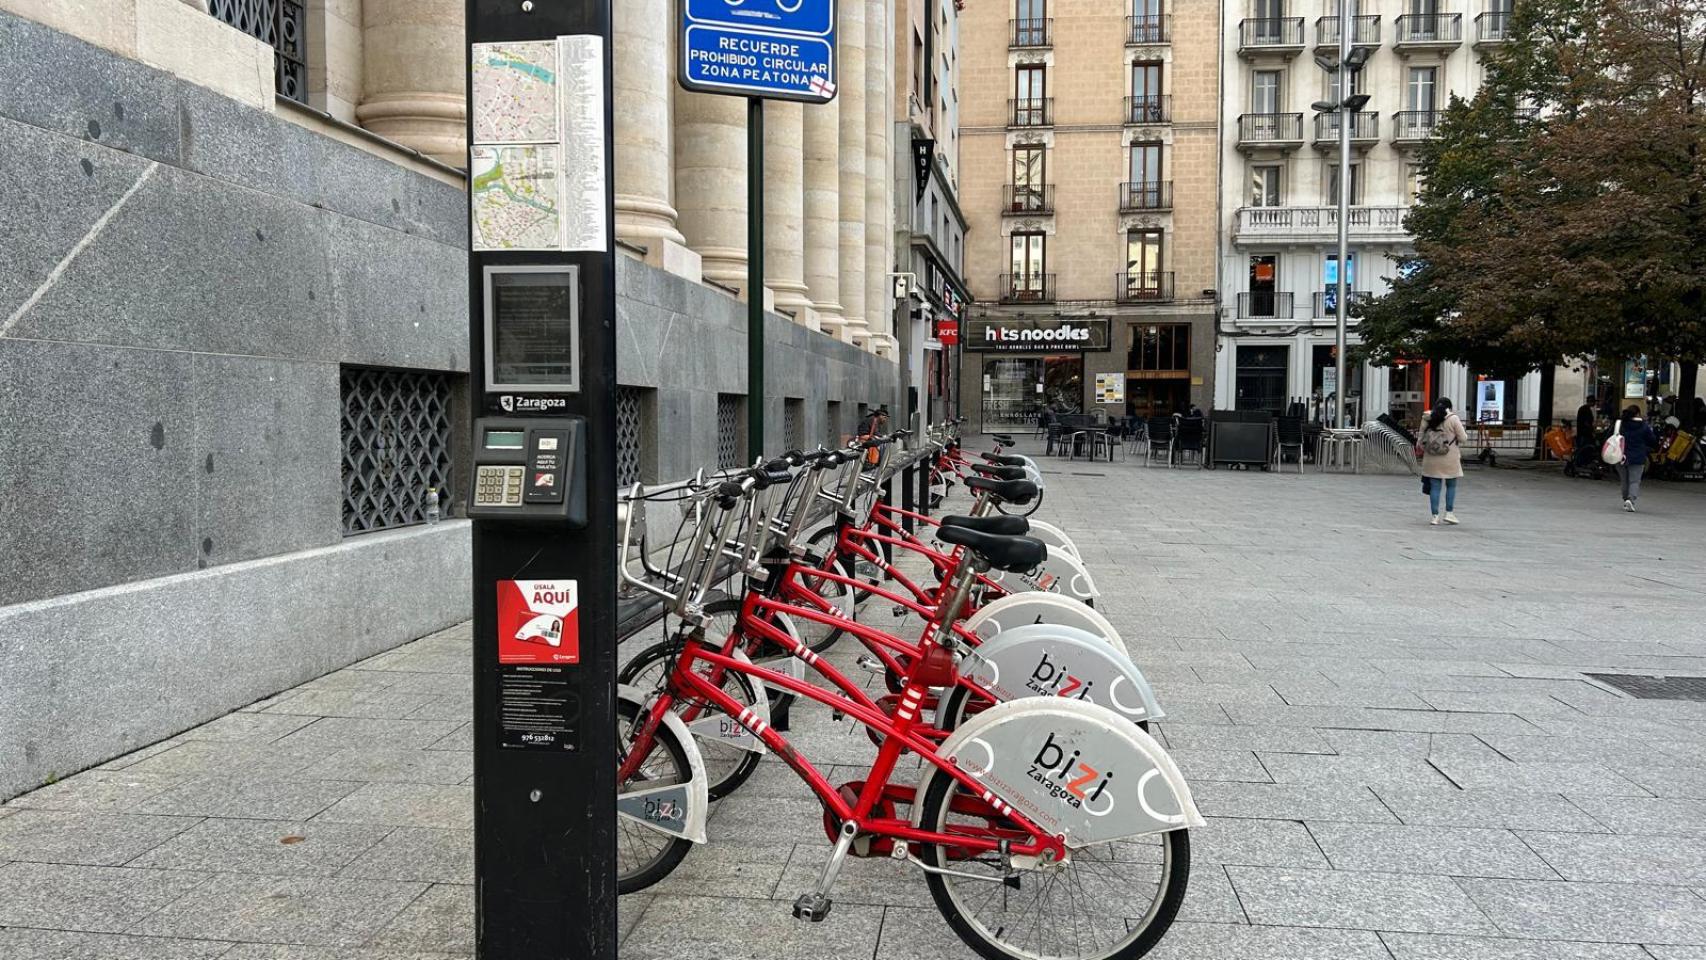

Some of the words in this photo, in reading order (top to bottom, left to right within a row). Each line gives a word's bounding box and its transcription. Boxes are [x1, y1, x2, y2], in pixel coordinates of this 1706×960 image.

[719, 37, 799, 57] RECUERDE
[690, 49, 757, 67] PROHIBIDO
[762, 57, 827, 74] CIRCULAR
[701, 63, 740, 79] ZONA
[743, 69, 815, 86] PEATONA
[1021, 324, 1090, 341] noodles
[516, 397, 566, 411] Zaragoza
[533, 589, 571, 605] AQUÍ
[1032, 653, 1093, 700] bizi
[521, 734, 533, 742] 976
[1034, 732, 1113, 801] bizi
[1027, 765, 1081, 809] Zaragoza
[644, 796, 677, 816] bizi
